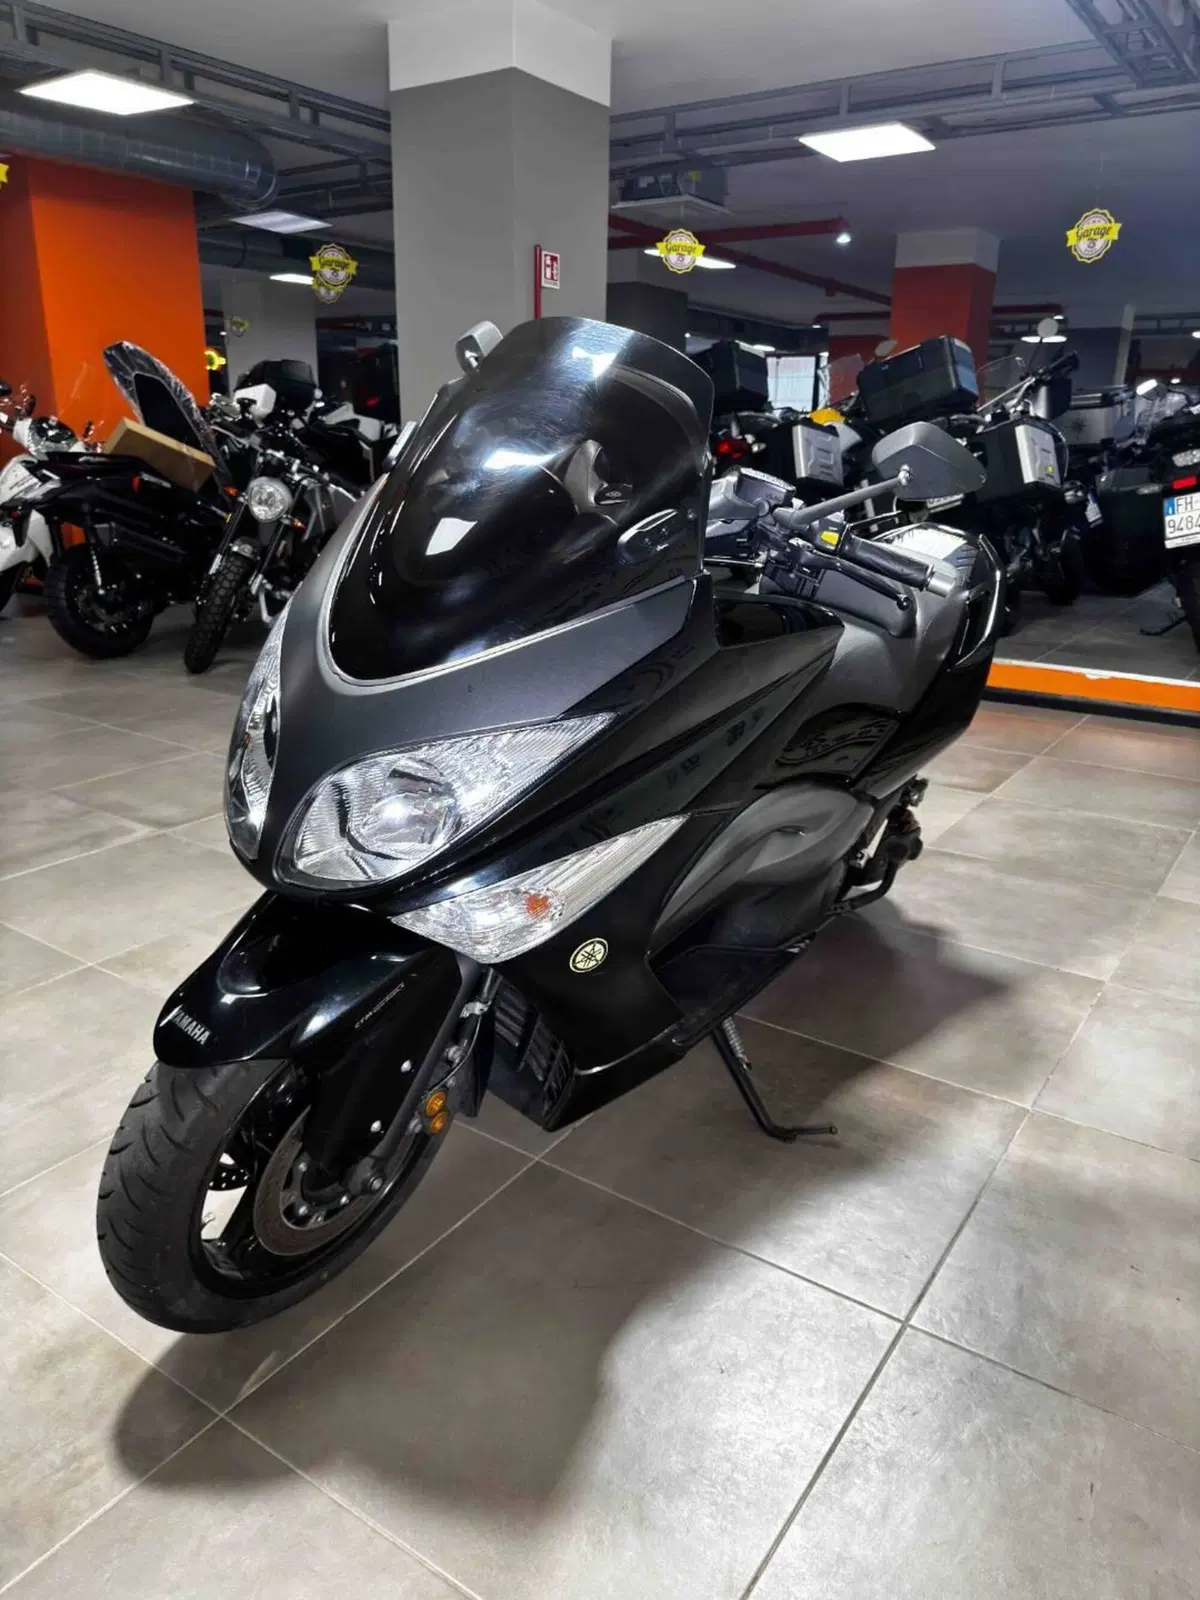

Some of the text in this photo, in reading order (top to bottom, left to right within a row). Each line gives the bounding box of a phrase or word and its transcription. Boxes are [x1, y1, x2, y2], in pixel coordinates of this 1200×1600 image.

[1076, 226, 1112, 240] Garage
[665, 242, 698, 255] Garage
[319, 256, 350, 271] Garage
[1176, 496, 1193, 514] FH
